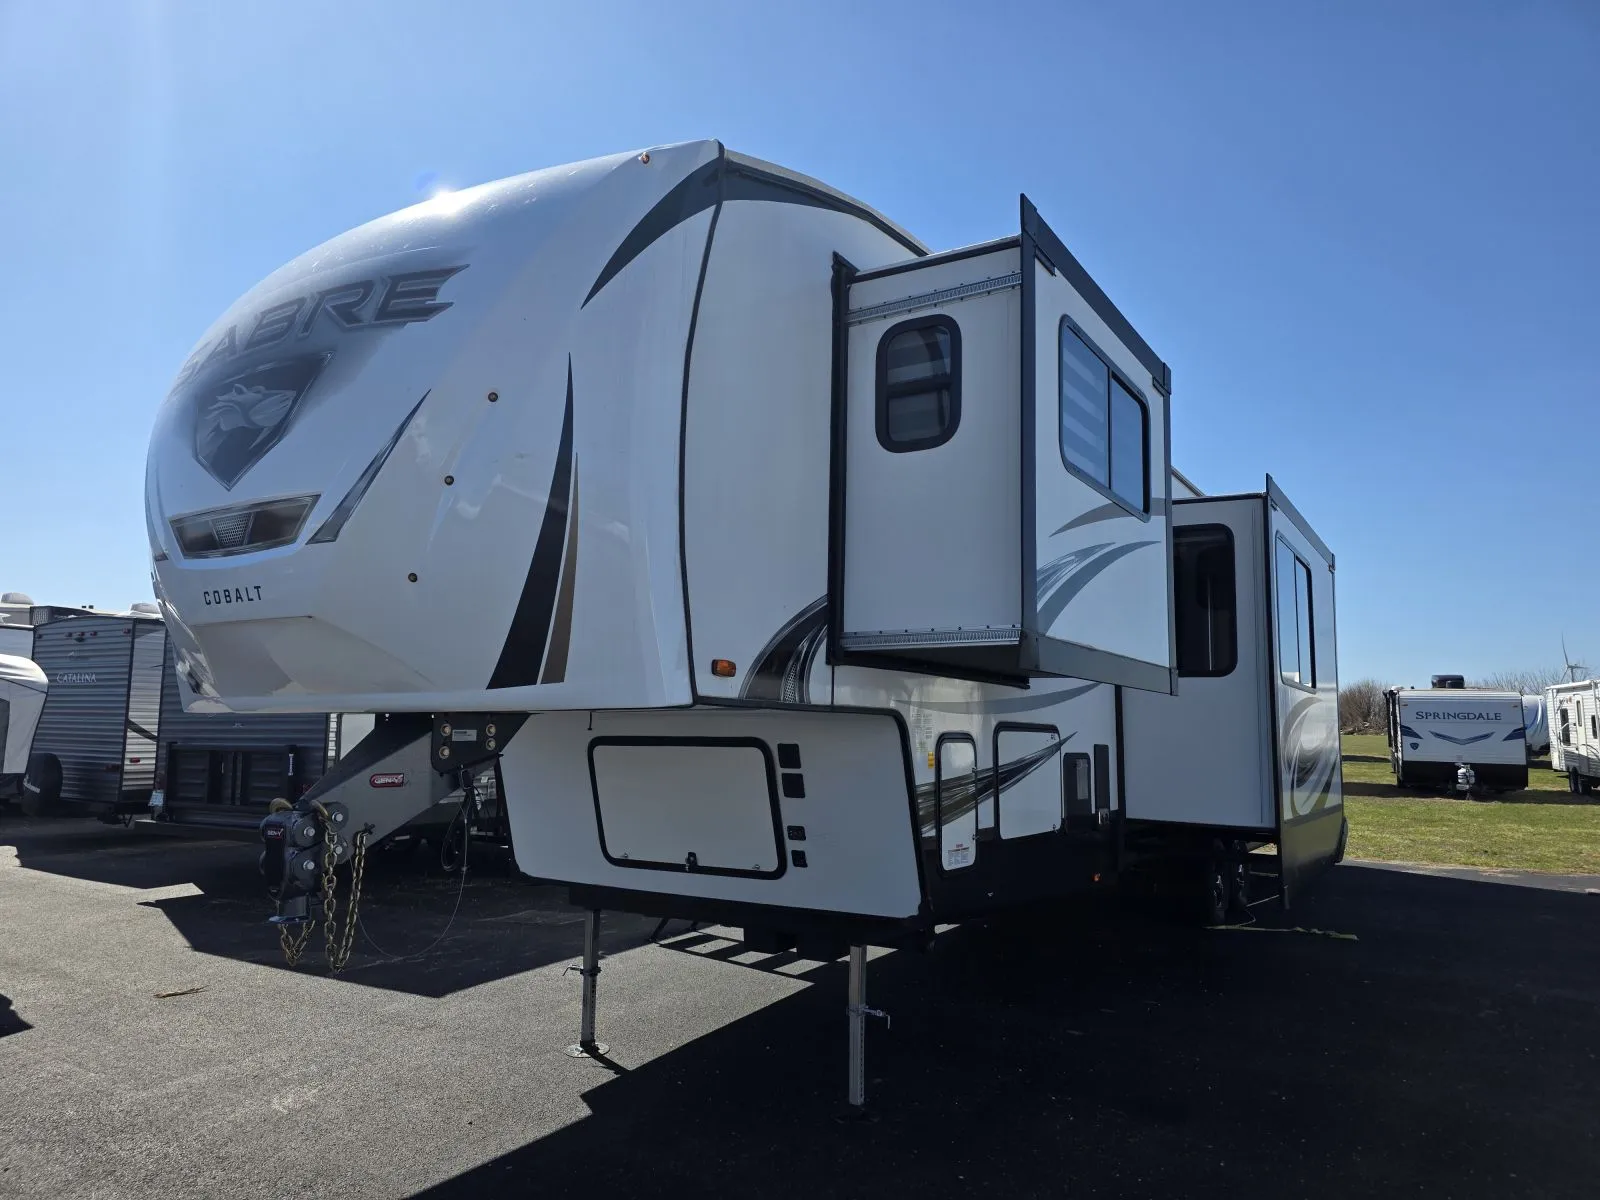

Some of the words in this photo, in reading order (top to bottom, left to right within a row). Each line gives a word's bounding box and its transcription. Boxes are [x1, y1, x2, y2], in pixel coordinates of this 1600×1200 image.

[203, 585, 262, 606] COBALT
[56, 672, 97, 684] CATALINA
[1415, 711, 1502, 721] SPRINGDALE
